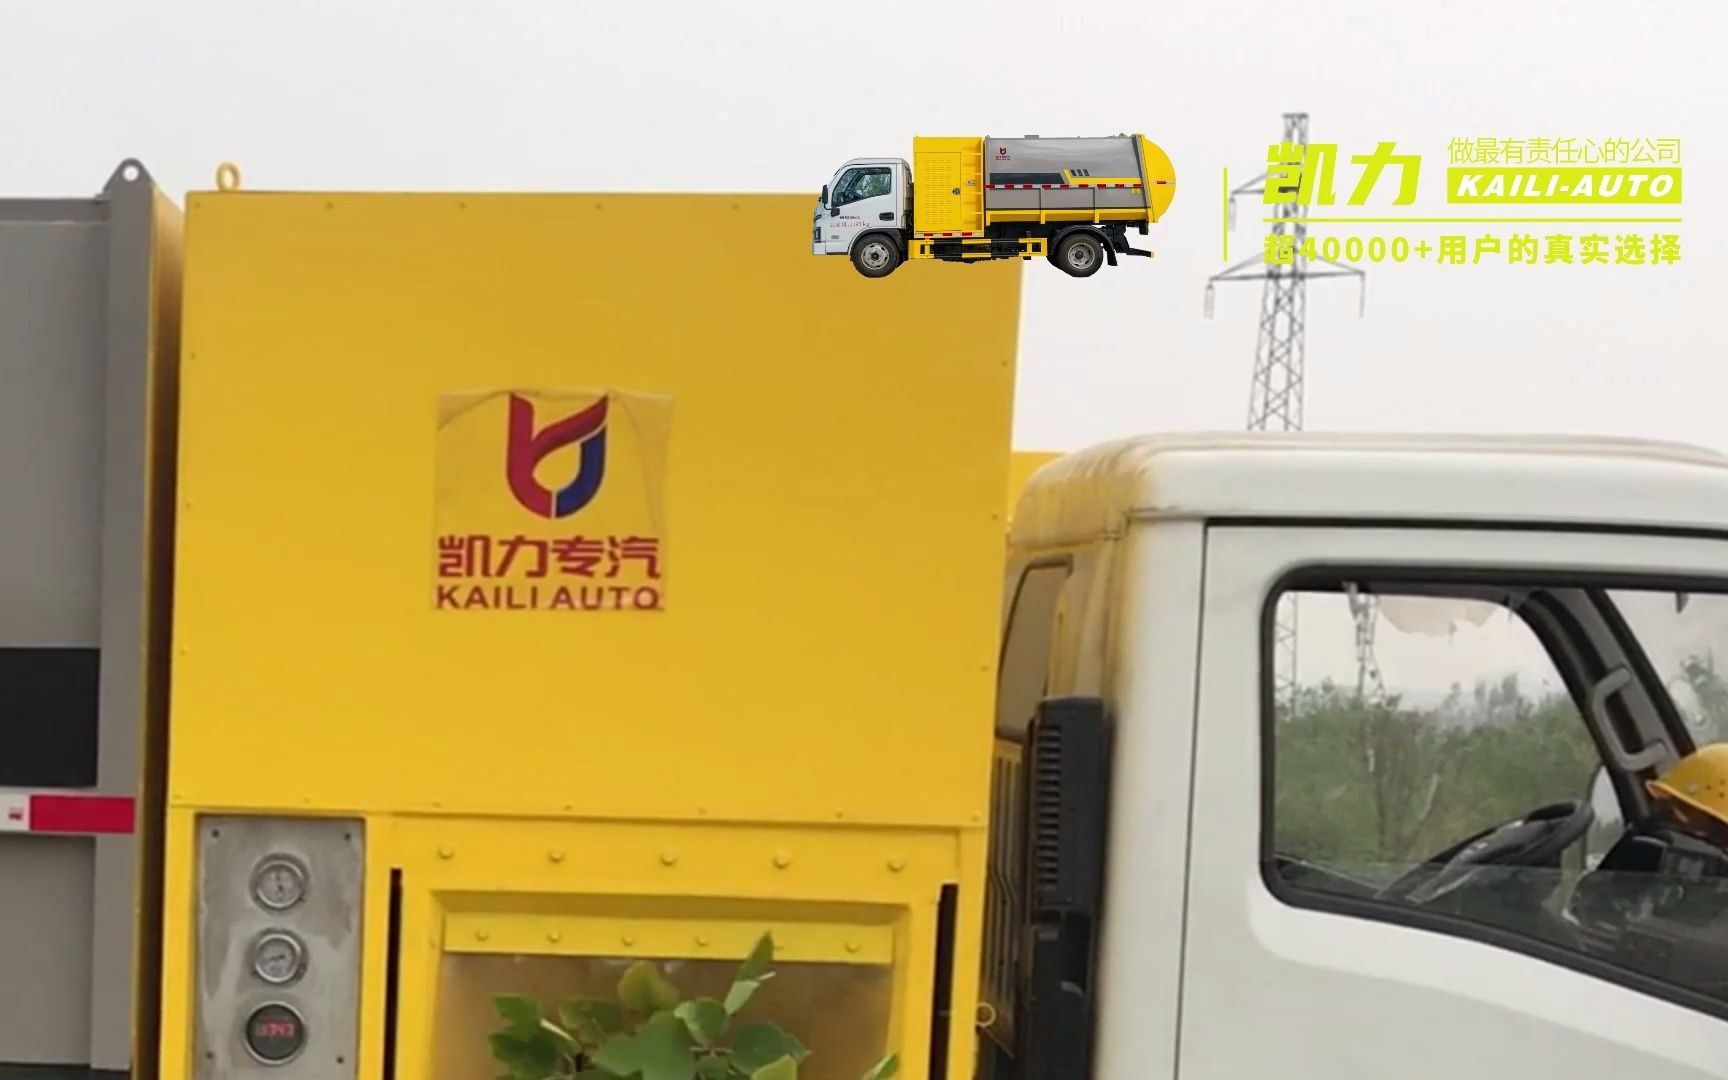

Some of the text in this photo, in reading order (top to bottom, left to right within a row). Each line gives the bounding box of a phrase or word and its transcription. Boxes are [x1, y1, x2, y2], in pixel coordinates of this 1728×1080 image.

[437, 533, 662, 580] 凯力专汽
[436, 584, 661, 611] KAILI AUTO
